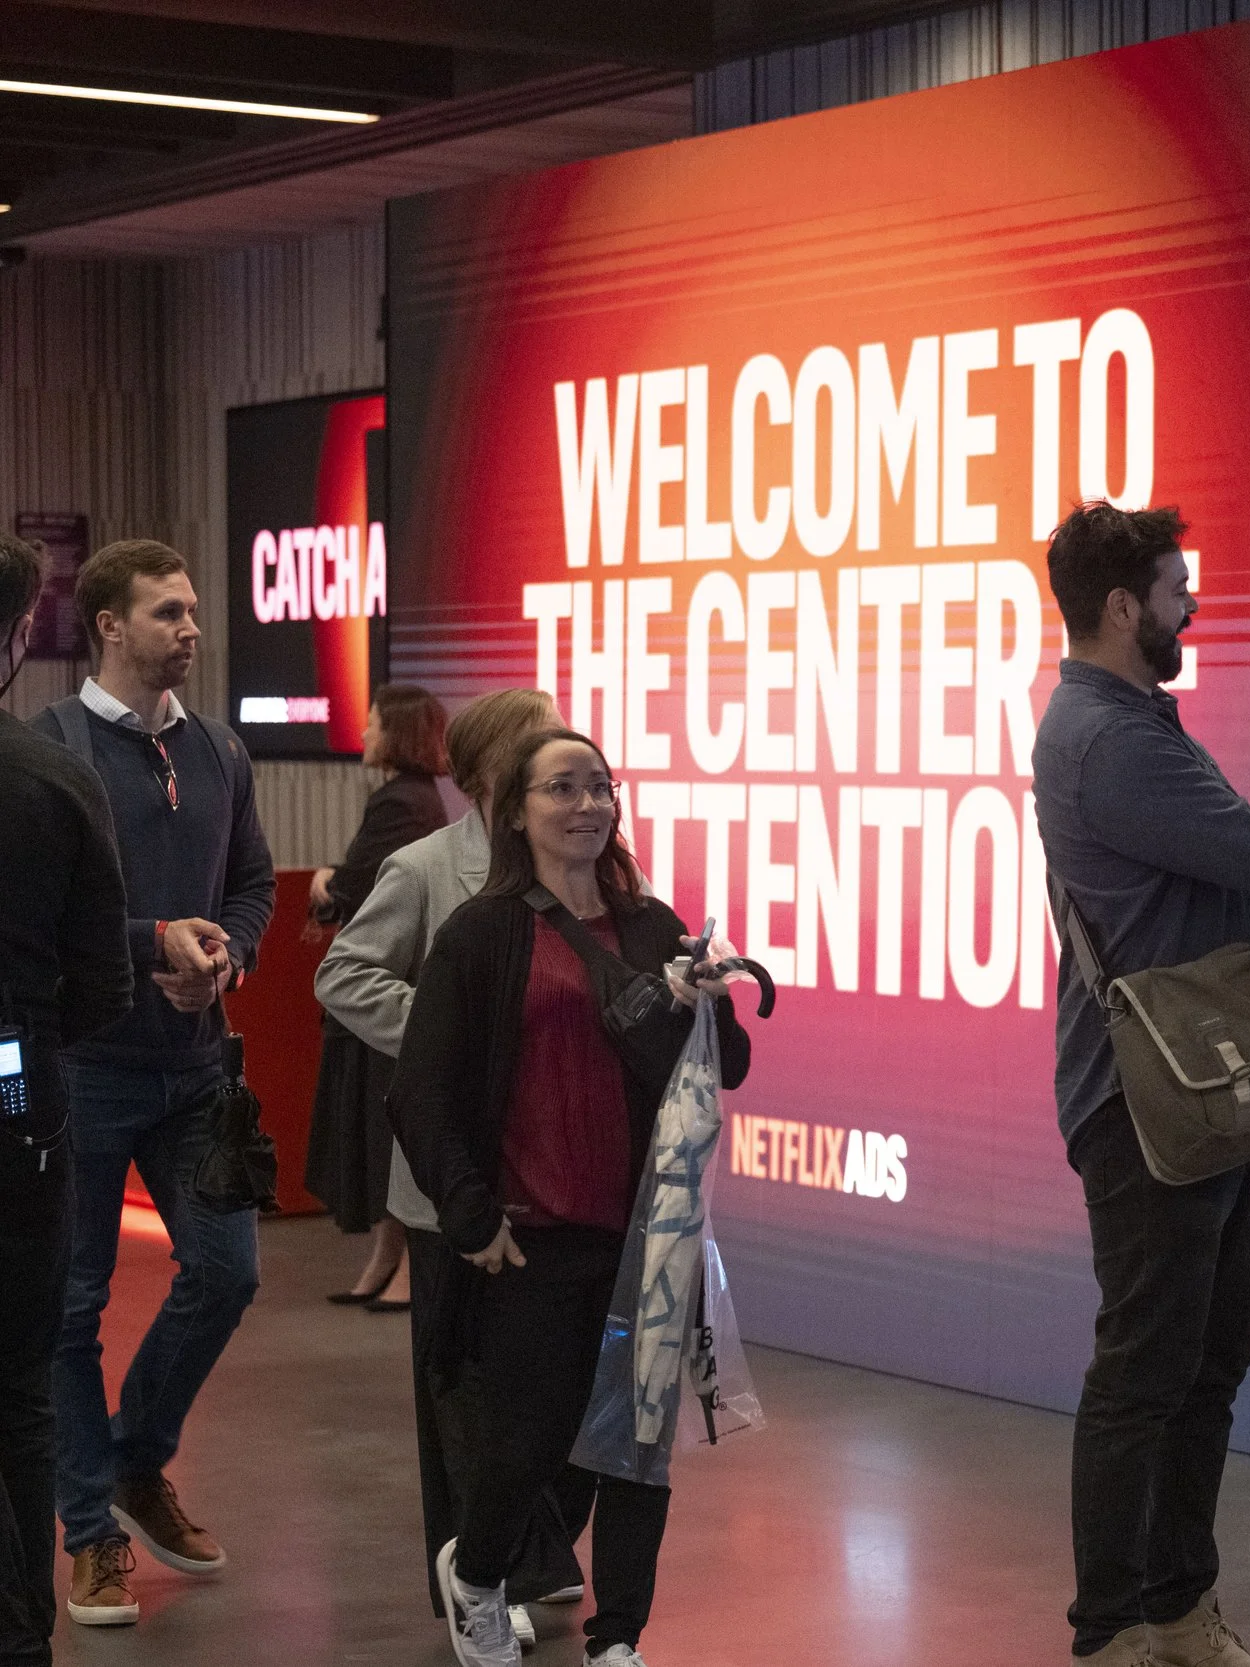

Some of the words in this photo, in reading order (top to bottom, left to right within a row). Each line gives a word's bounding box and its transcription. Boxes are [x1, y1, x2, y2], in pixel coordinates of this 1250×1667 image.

[555, 328, 999, 568] WELCOME
[1014, 309, 1154, 542] TO
[253, 525, 361, 623] CATCH
[523, 577, 673, 770] THE
[685, 559, 1043, 777] CENTER
